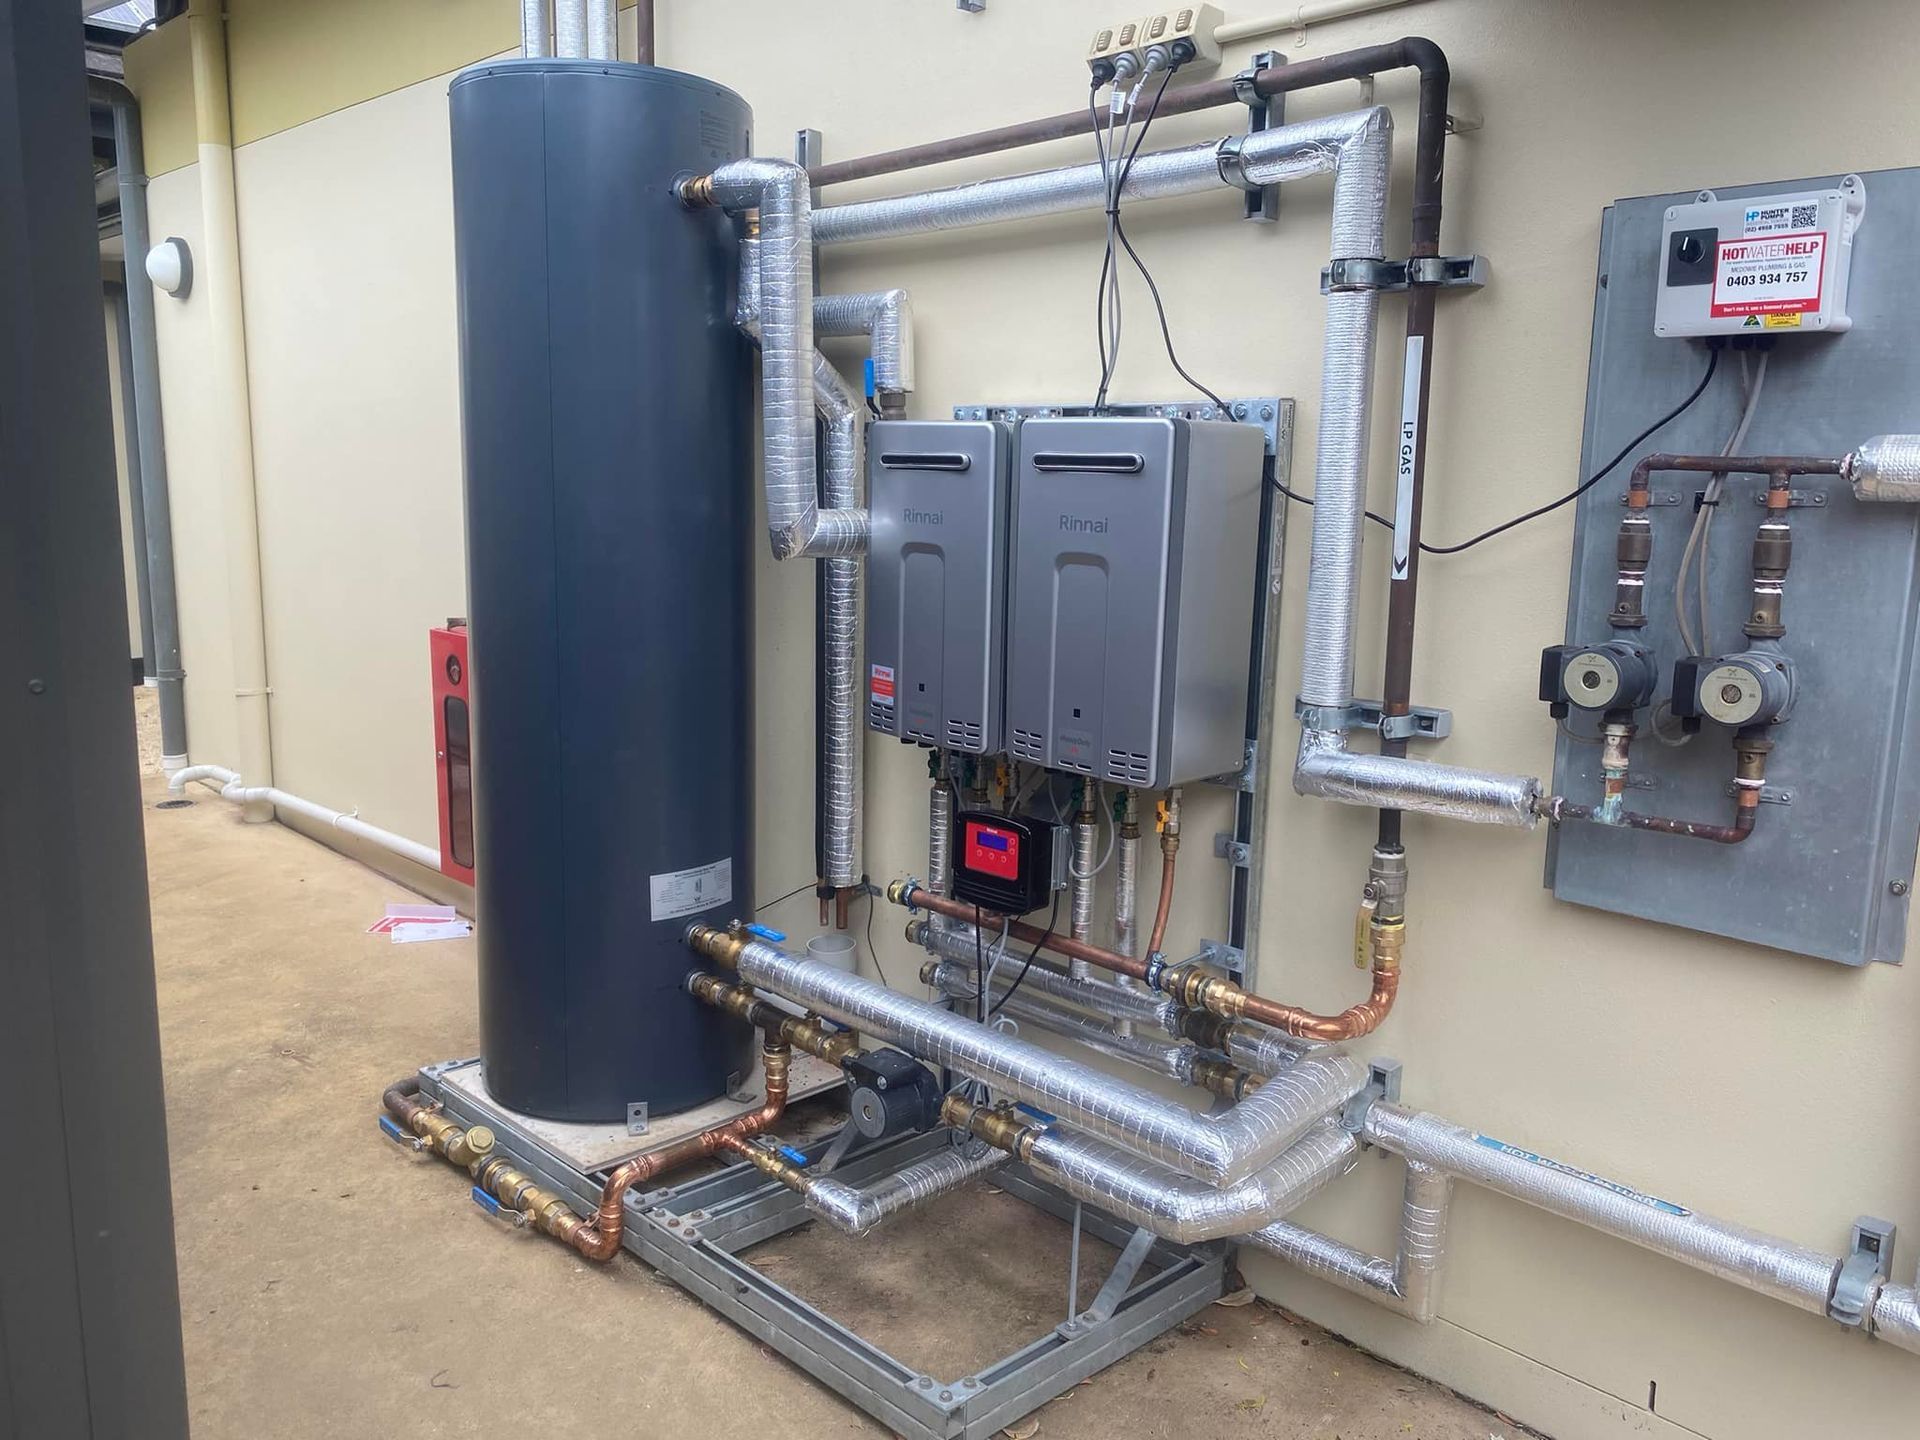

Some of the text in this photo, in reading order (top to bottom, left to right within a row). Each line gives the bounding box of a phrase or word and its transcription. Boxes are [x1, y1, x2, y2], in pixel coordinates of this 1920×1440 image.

[1746, 211, 1760, 222] HP
[1722, 241, 1819, 260] HOTWATERHELP
[1758, 263, 1787, 272] PLUMBING
[1727, 271, 1808, 287] 0403 934 757
[1400, 421, 1414, 475] LP GAS
[903, 507, 944, 526] Rinnai
[1059, 514, 1109, 534] Rinnai
[1500, 1145, 1534, 1160] HOT
